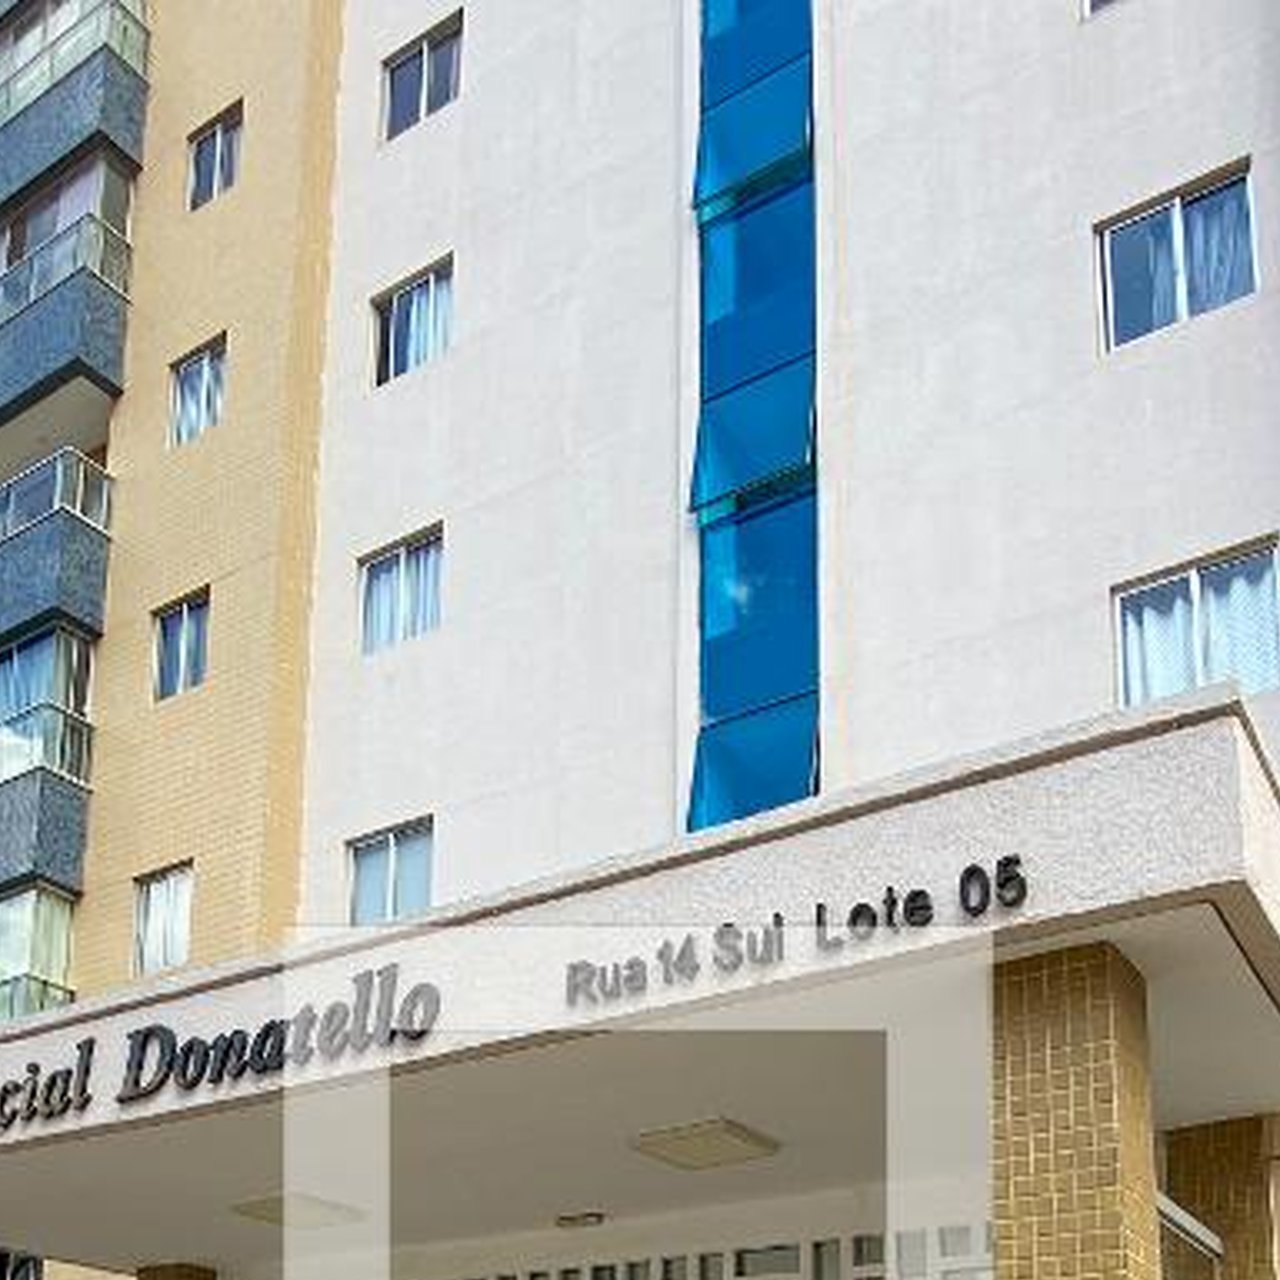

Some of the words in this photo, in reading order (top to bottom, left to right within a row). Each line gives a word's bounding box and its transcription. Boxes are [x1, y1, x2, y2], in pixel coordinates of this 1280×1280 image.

[565, 956, 648, 1007] Rua
[656, 932, 702, 988] 14
[712, 912, 785, 974] Sul
[815, 885, 935, 952] Lote
[957, 854, 1028, 919] 05
[115, 962, 445, 1106] Donatello
